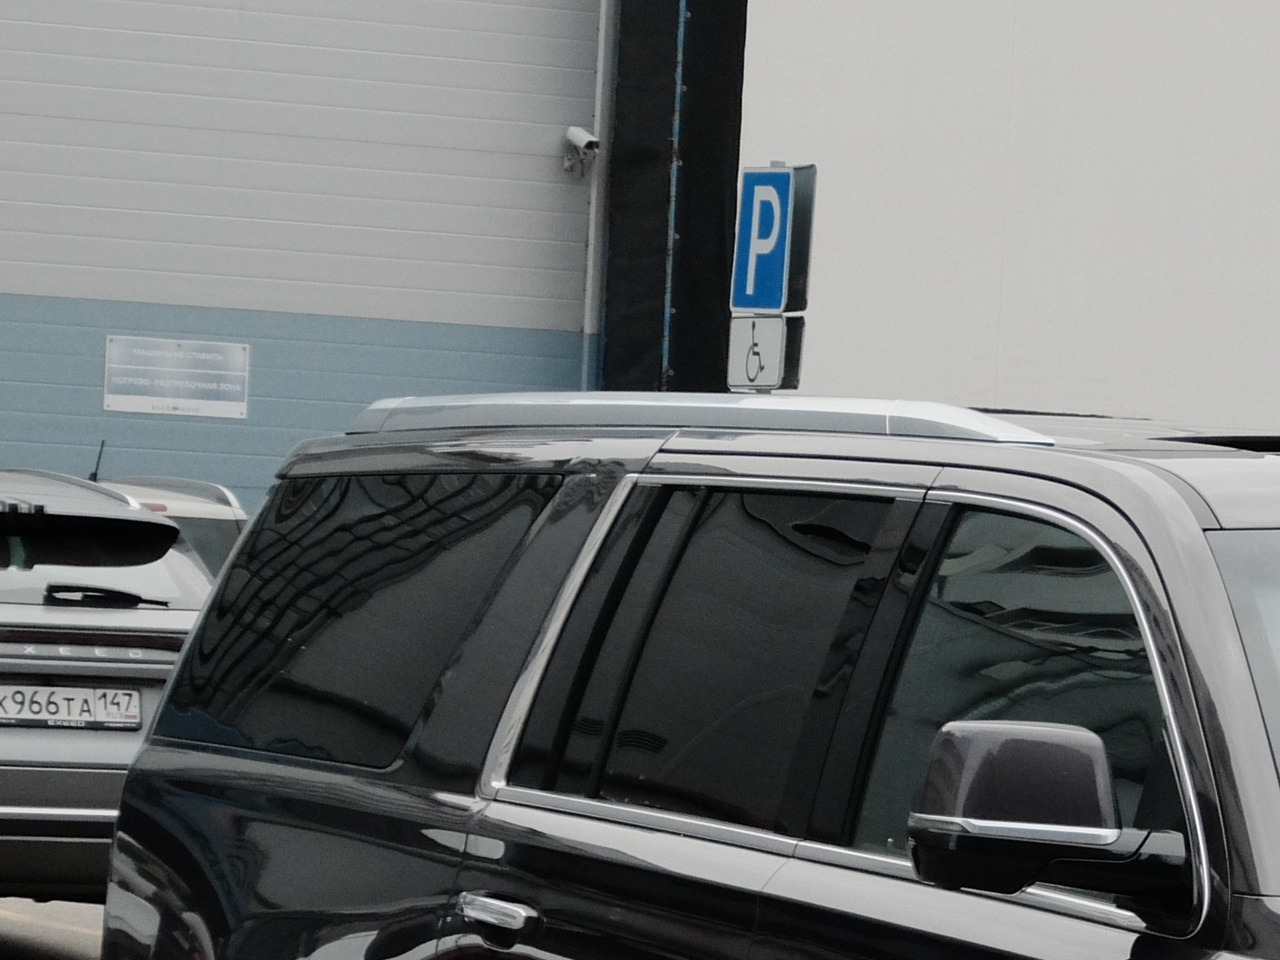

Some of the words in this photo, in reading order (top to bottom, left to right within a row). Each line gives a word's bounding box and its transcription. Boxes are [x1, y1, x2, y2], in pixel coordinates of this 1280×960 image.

[746, 185, 781, 295] P
[98, 692, 133, 711] 147
[106, 711, 123, 719] RUS
